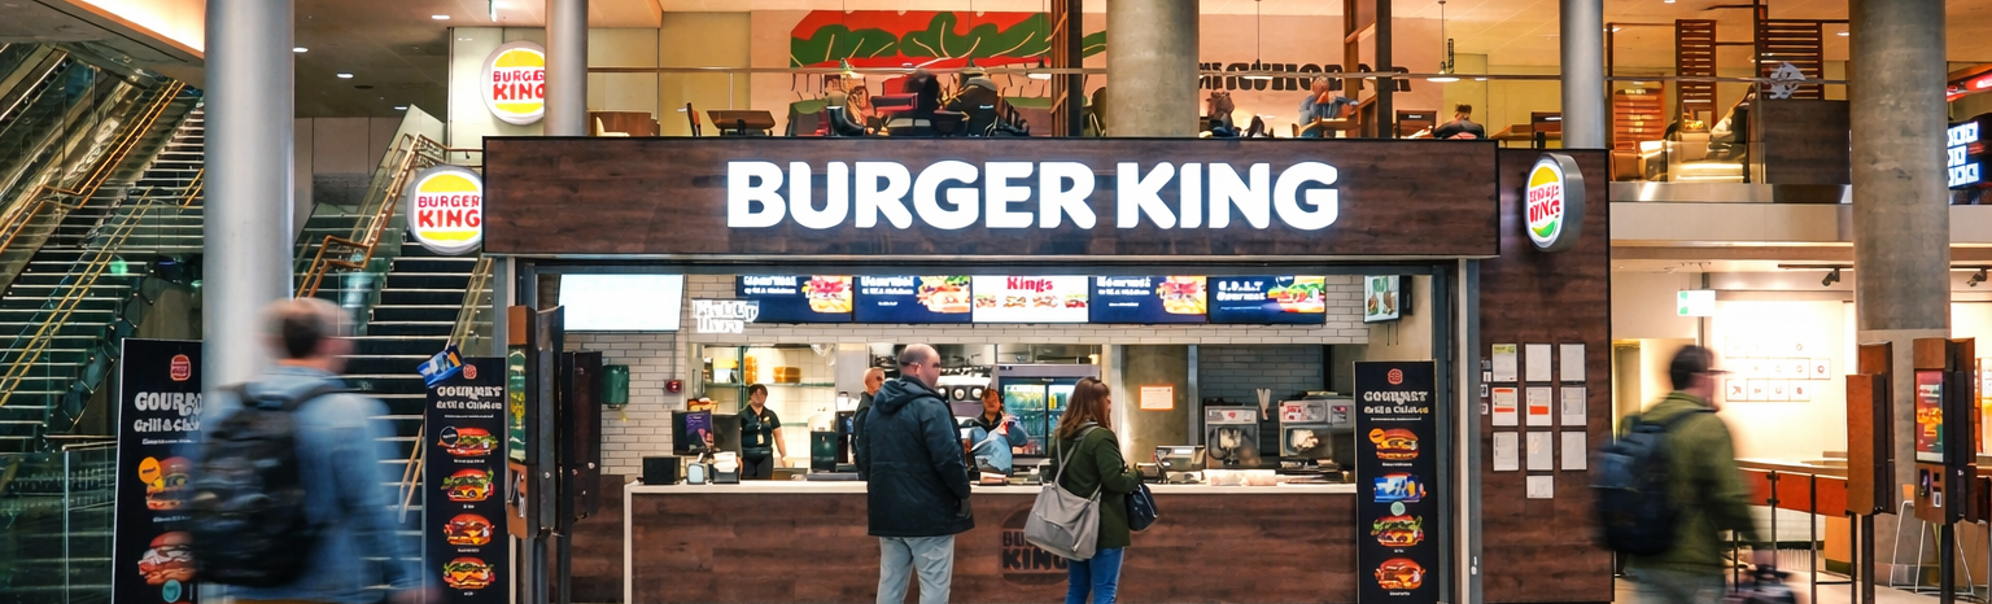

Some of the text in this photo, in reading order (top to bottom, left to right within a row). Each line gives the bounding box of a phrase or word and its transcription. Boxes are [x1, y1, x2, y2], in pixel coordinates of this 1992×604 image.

[418, 195, 480, 208] BURGER
[726, 160, 1339, 230] BURGER KING
[418, 209, 481, 228] KING
[1006, 276, 1053, 292] Kings
[134, 391, 202, 416] GOURM
[133, 418, 161, 432] Grill
